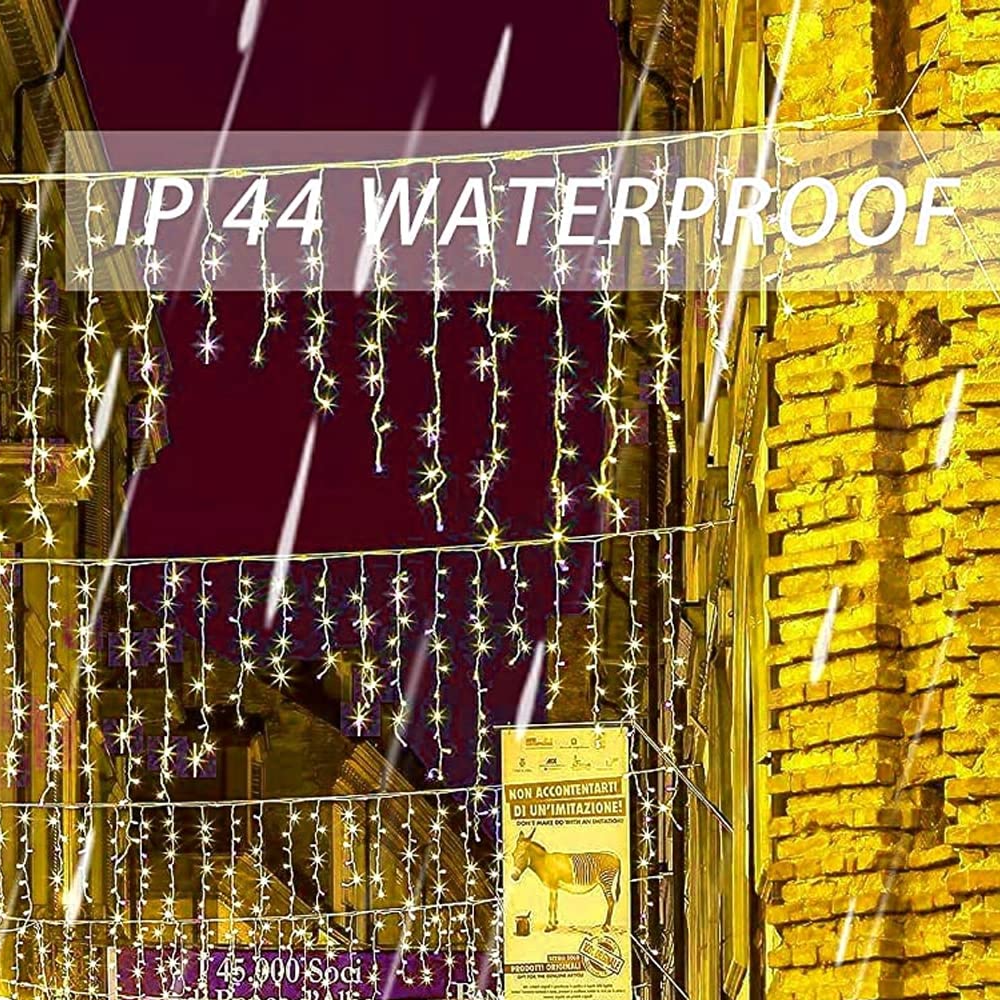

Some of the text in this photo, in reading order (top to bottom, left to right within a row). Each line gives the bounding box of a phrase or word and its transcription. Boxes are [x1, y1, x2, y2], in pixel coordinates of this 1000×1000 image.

[508, 781, 617, 800] NON ACCONTENTARTI
[514, 800, 623, 817] DI UN'IMITAZIONE!
[216, 957, 300, 983] 45.000
[309, 957, 362, 984] Soci
